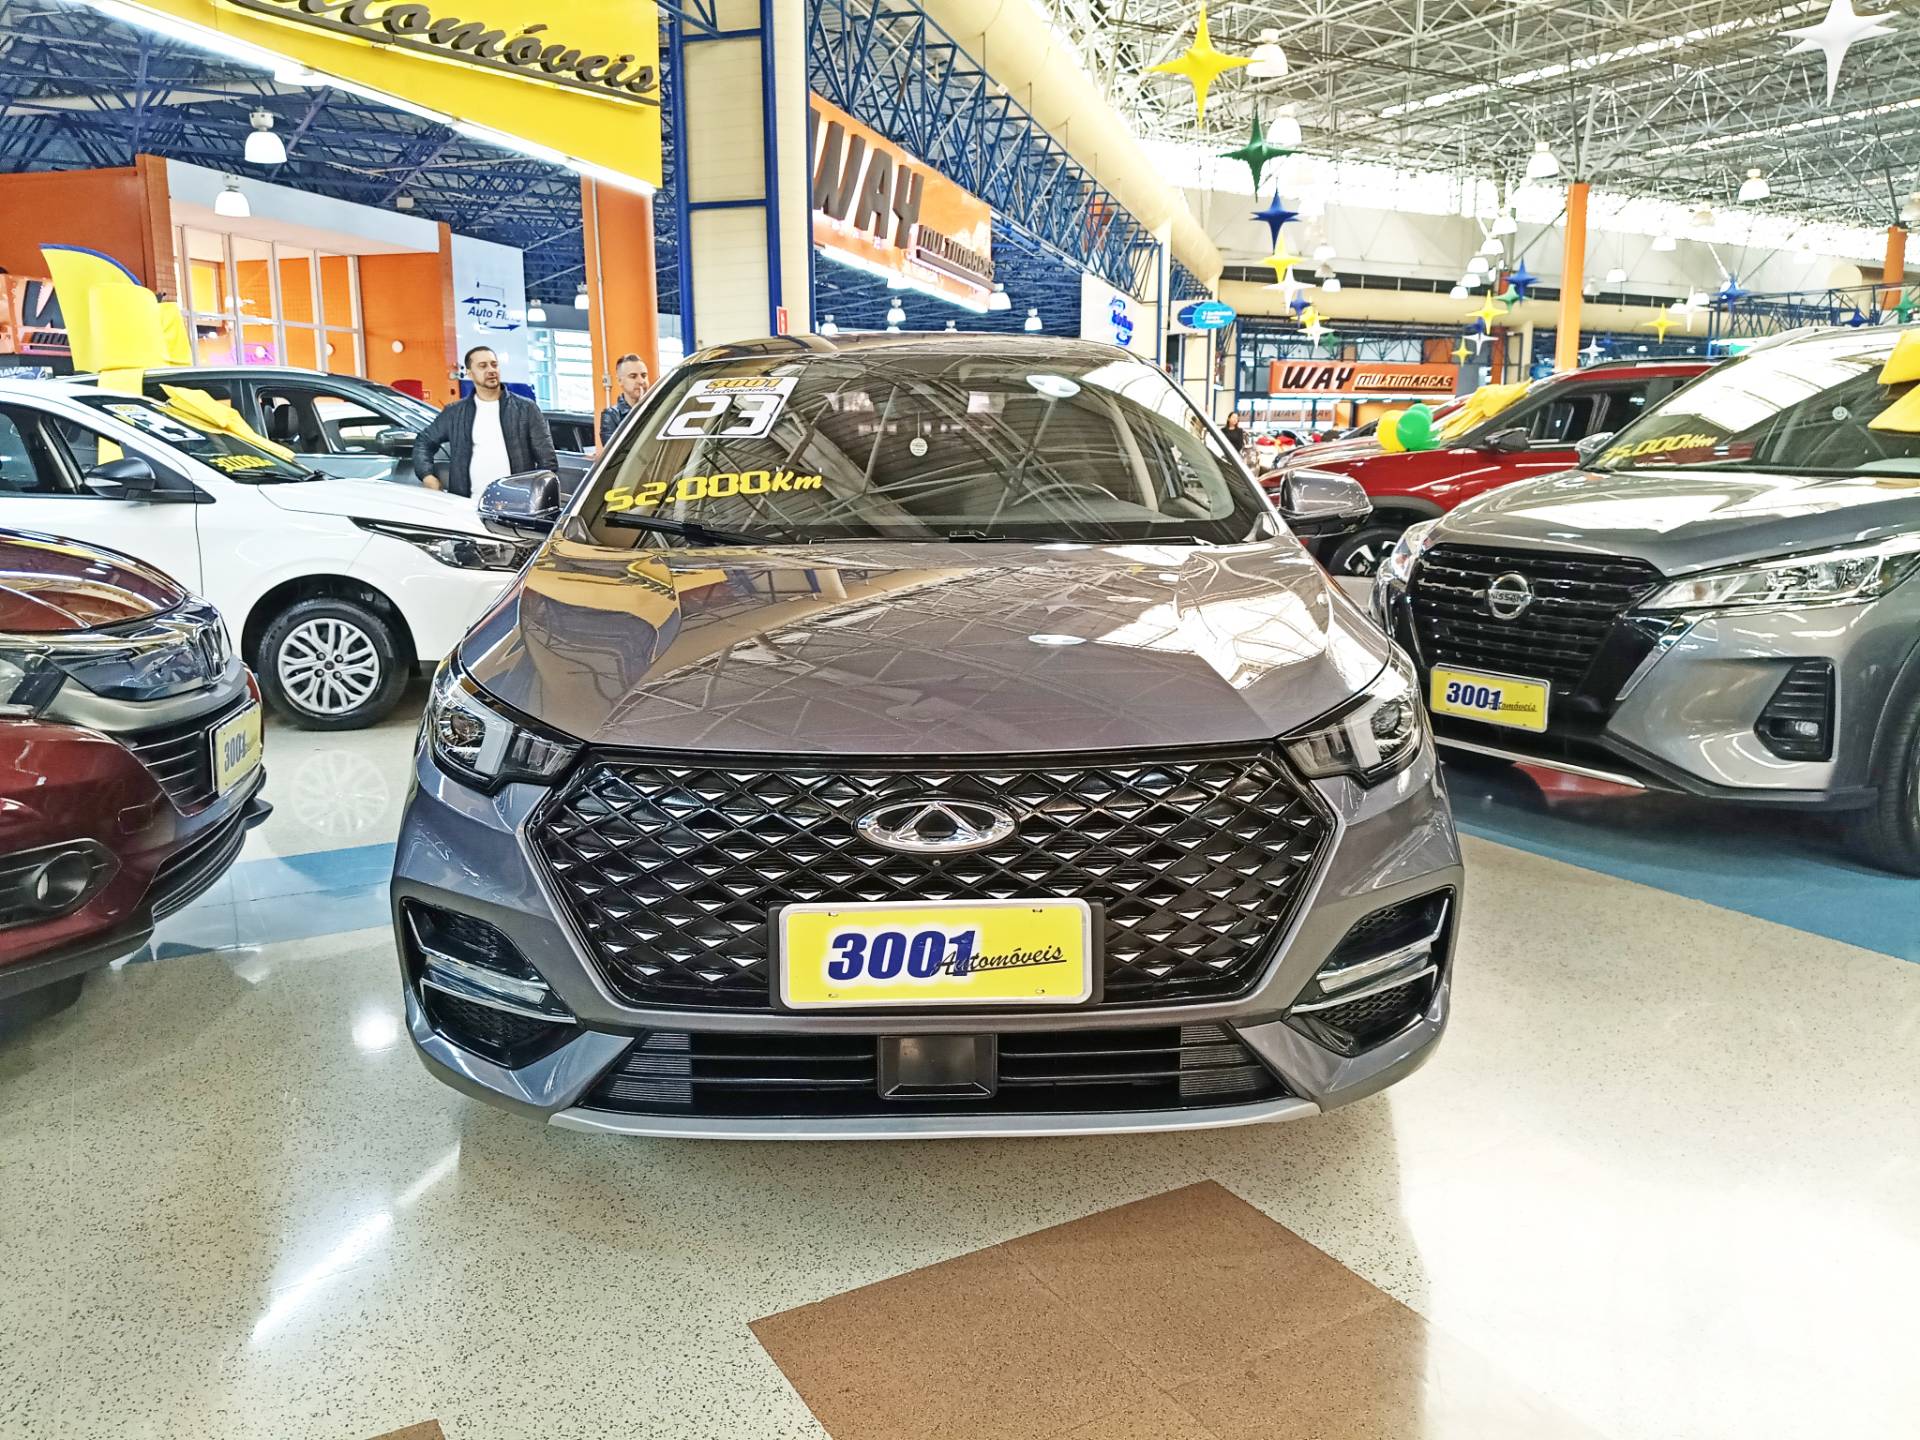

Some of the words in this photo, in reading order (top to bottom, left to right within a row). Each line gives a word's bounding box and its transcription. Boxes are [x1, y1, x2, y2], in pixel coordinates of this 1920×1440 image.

[272, 0, 657, 93] omóveis
[811, 109, 925, 249] WAY
[468, 306, 493, 318] Auto
[1281, 366, 1355, 389] WAY
[1357, 373, 1454, 387] MULTIMARCAS
[667, 394, 782, 436] 23
[1446, 682, 1501, 711] 3001
[224, 730, 247, 772] 3001
[827, 930, 976, 980] 3001
[931, 945, 1063, 976] Automóveis
